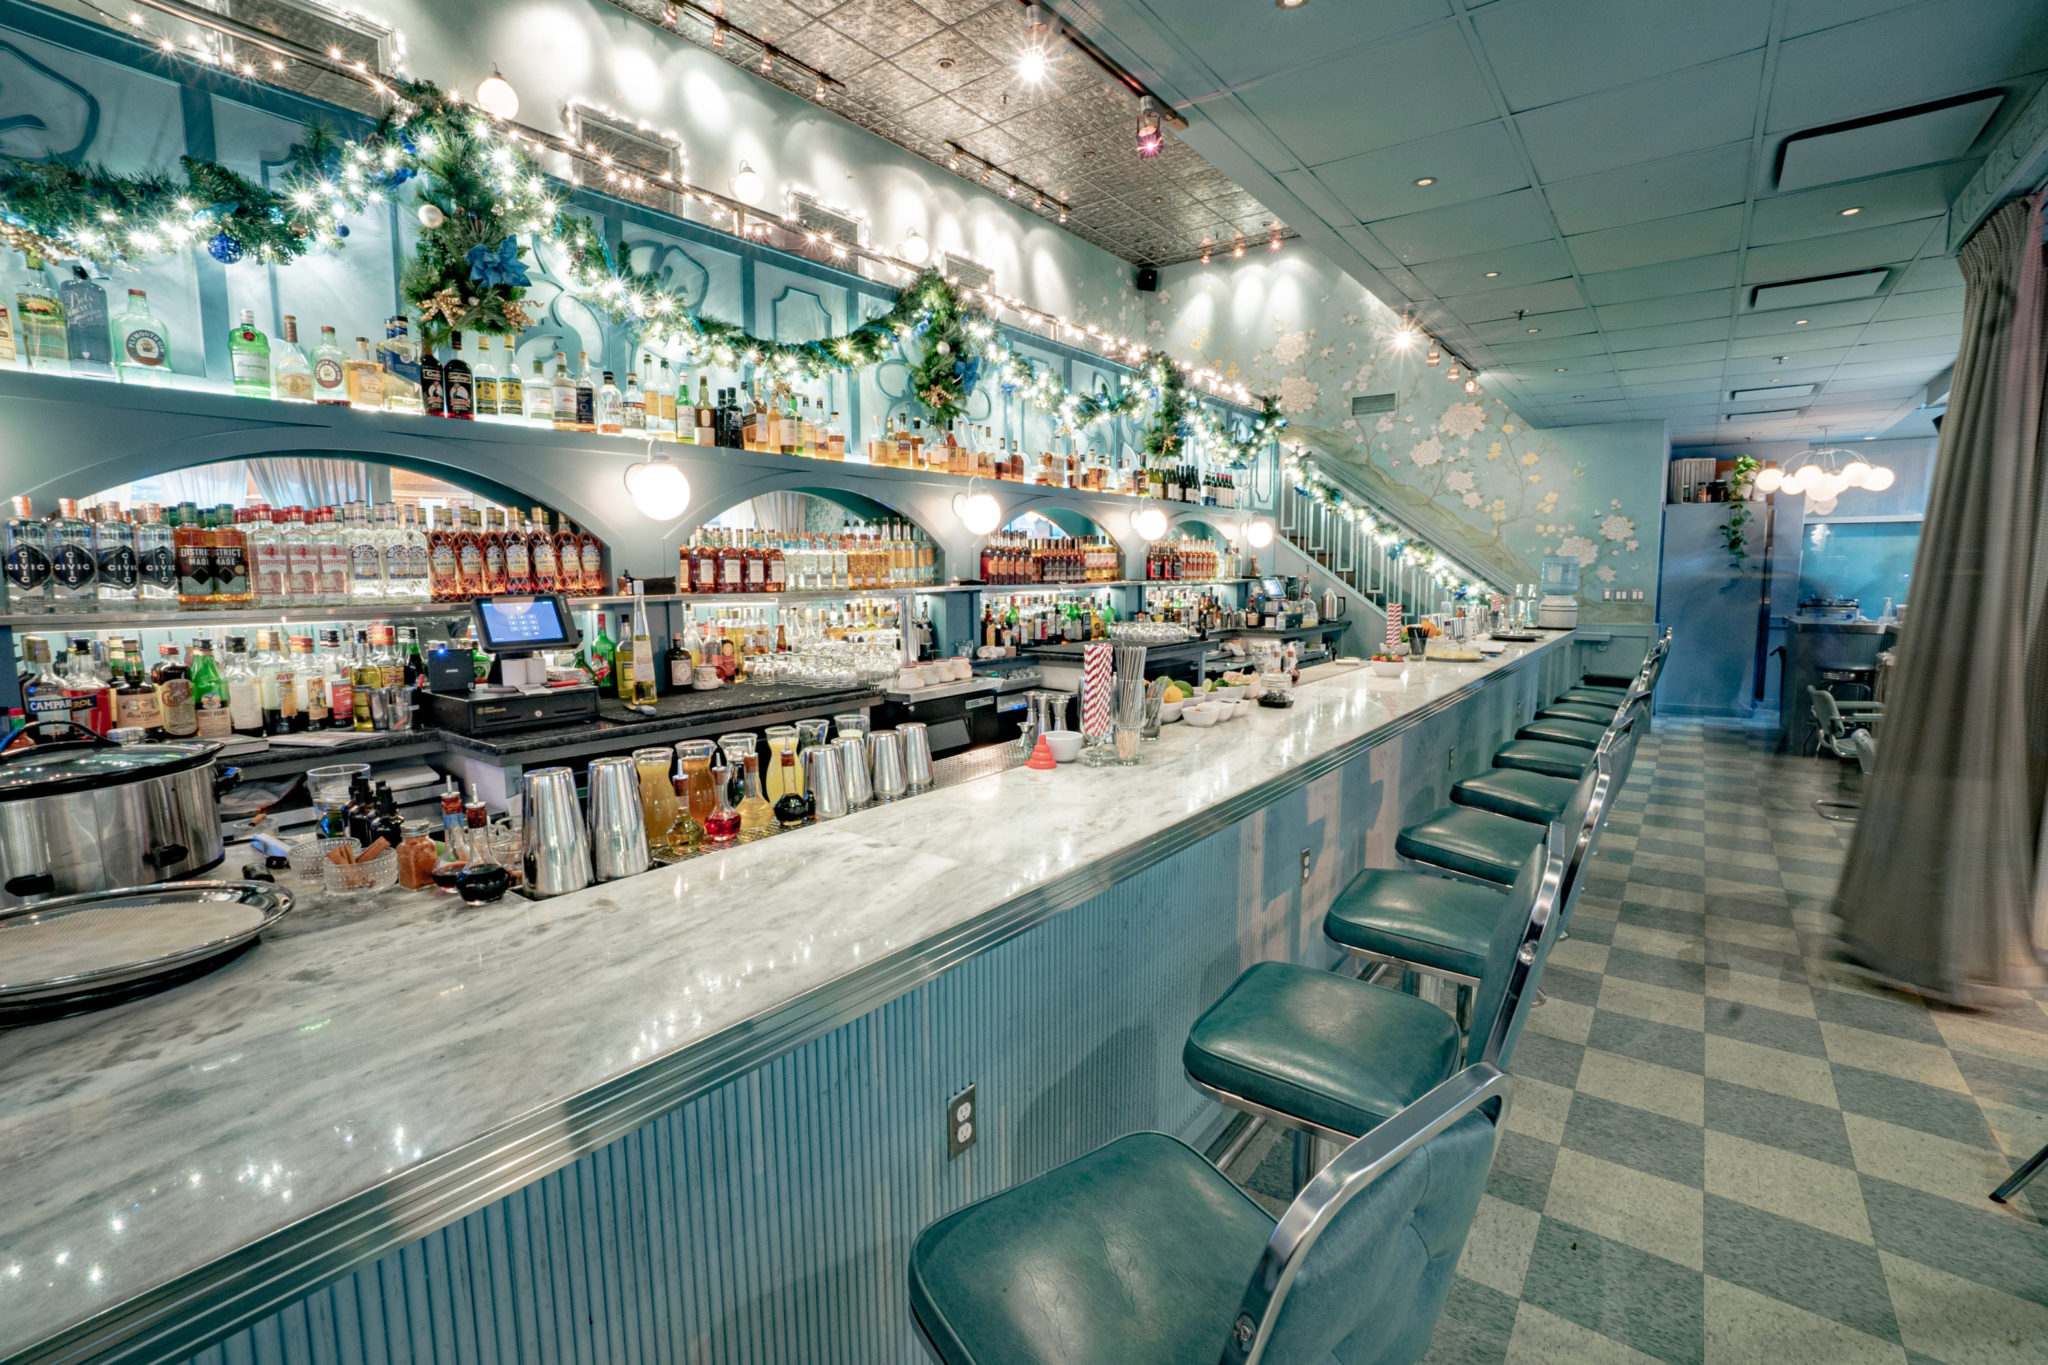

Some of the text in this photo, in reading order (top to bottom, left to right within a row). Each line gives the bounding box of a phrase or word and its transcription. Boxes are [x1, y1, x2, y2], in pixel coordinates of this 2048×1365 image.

[129, 331, 159, 348] PLYMOUTH
[181, 548, 209, 557] DISTRI
[215, 548, 241, 557] STRICT
[7, 563, 45, 571] CIVIC
[19, 551, 31, 583] CIVIC
[54, 563, 91, 571] CIVIC
[65, 551, 77, 583] CIVIC
[121, 552, 132, 583] CIVIC
[159, 553, 169, 583] CIVIC
[73, 699, 93, 708] ROL
